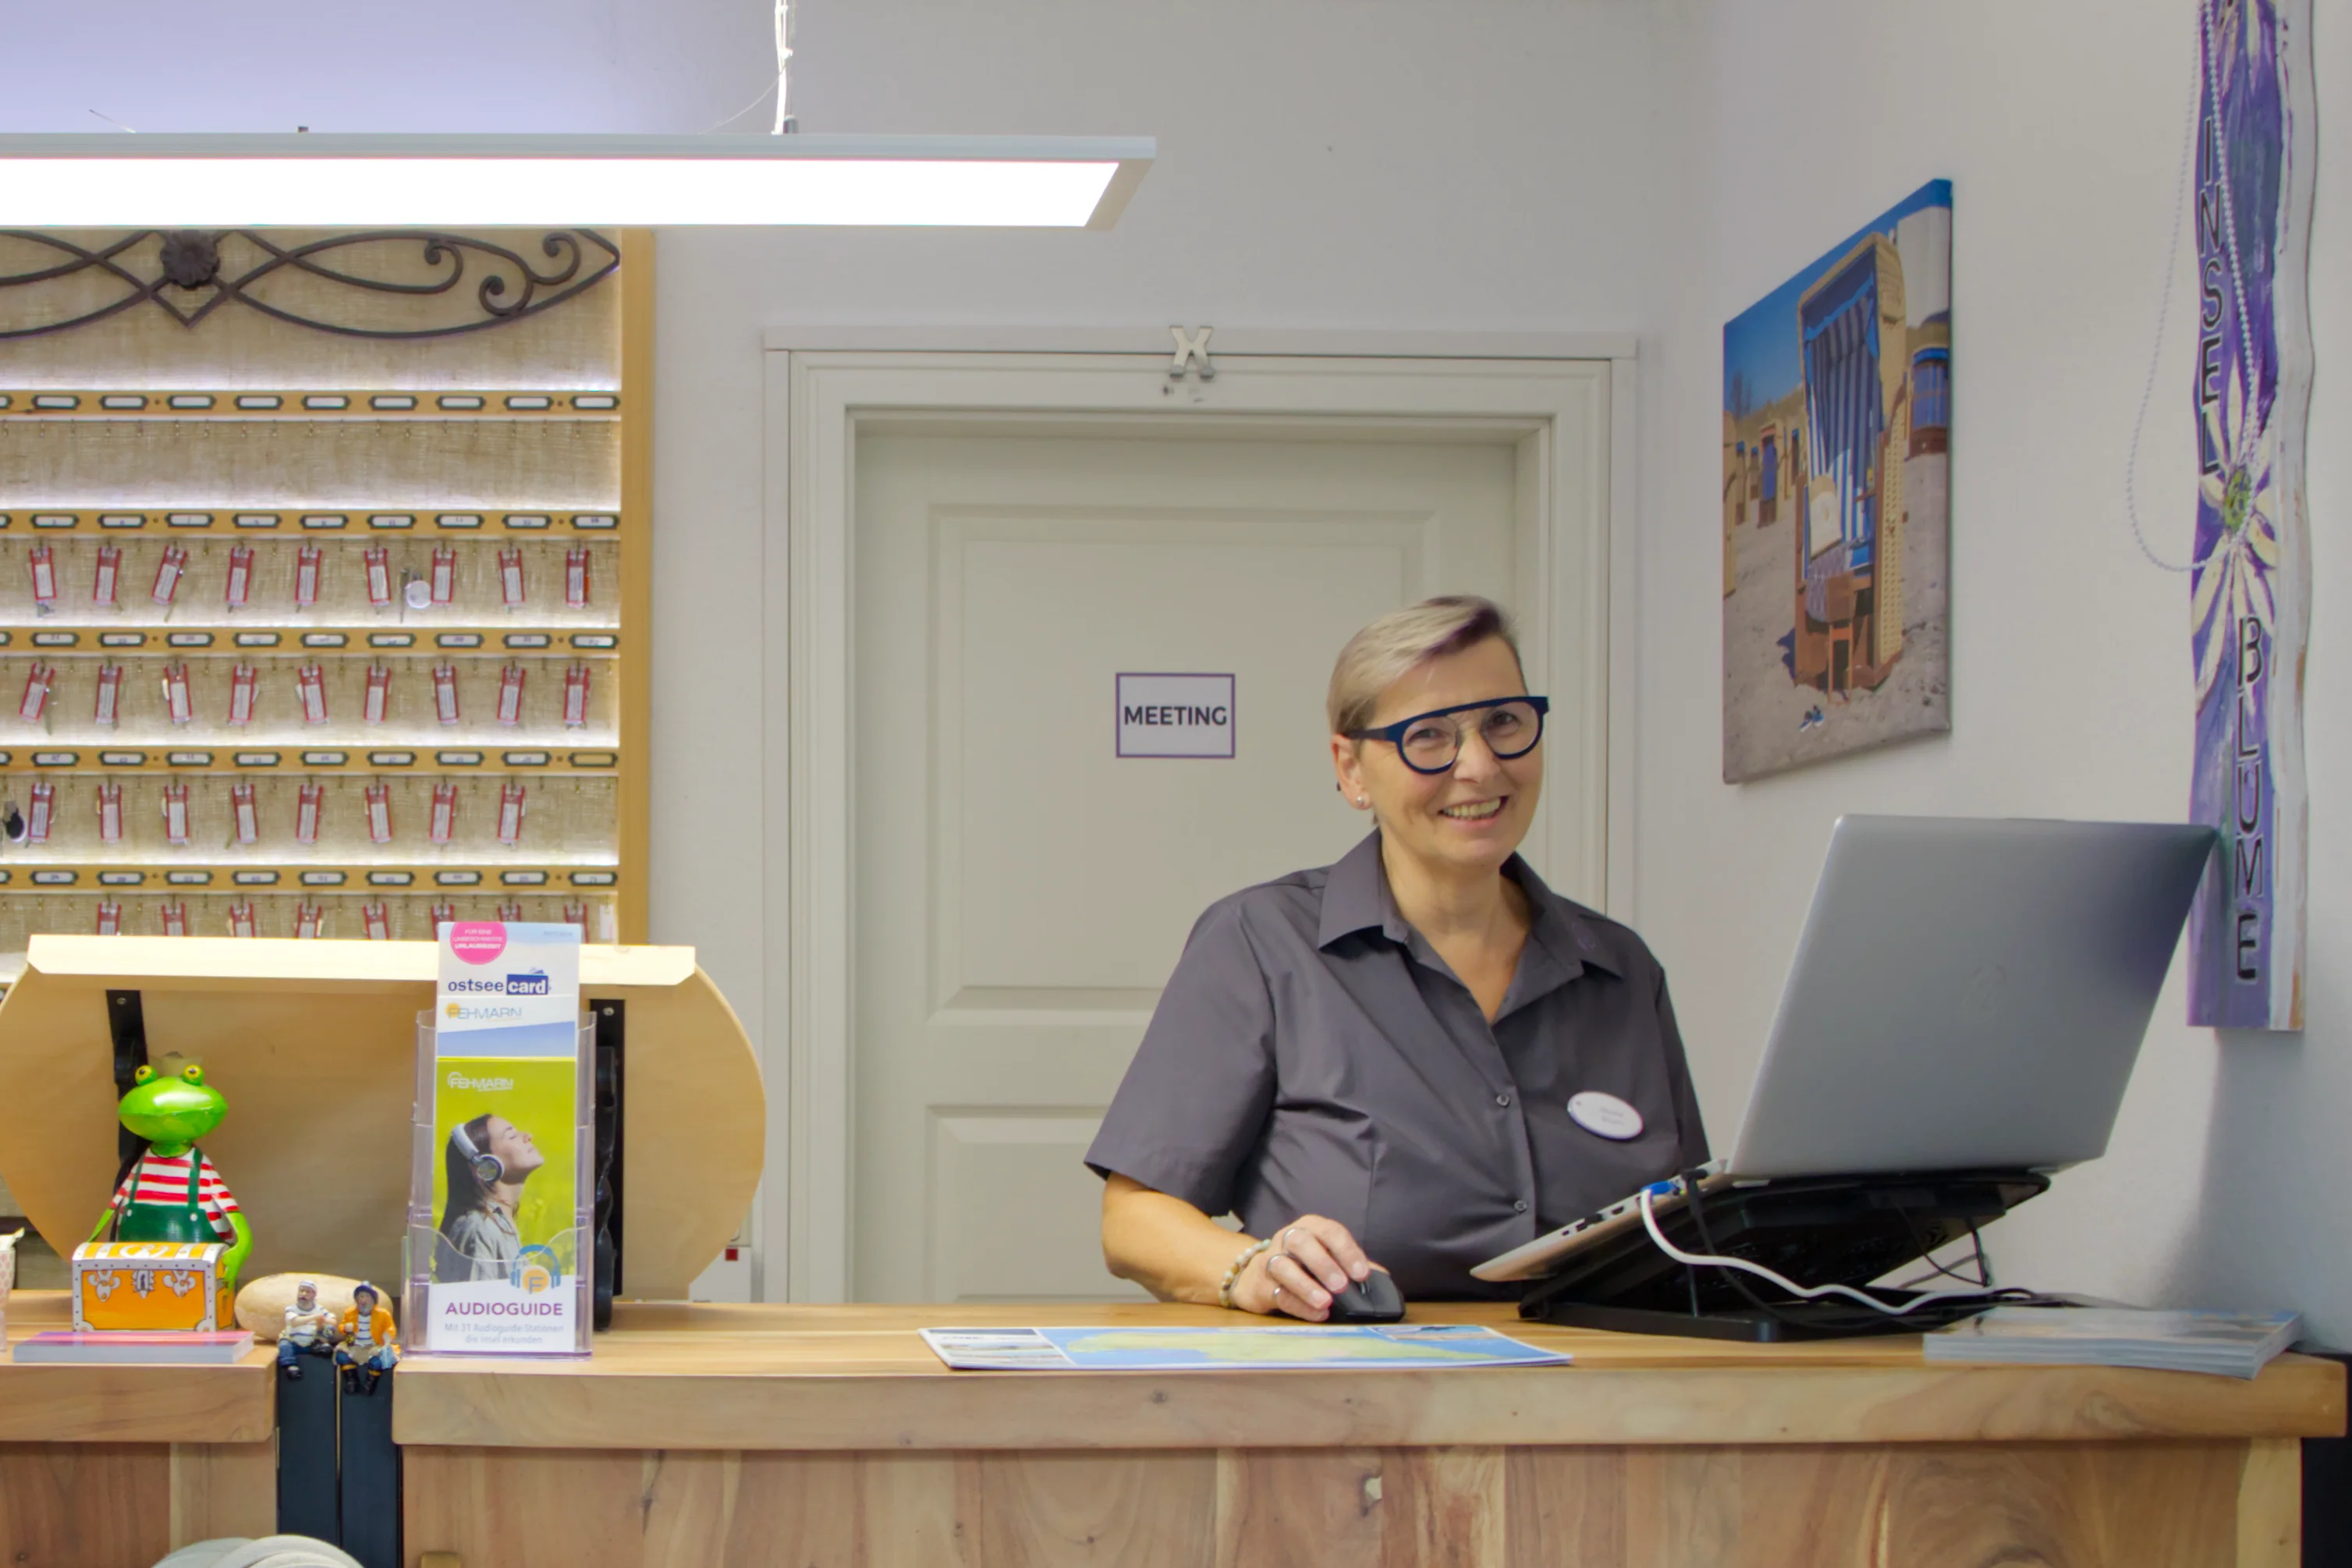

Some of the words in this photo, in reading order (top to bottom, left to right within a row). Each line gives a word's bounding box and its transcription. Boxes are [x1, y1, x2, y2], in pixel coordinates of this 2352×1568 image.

[2199, 117, 2223, 476] INSEL
[1124, 706, 1227, 725] MEETING
[2234, 616, 2262, 982] BLUME
[448, 979, 504, 992] ostsee
[508, 979, 546, 994] card
[448, 1007, 523, 1020] FEHMARN
[450, 1077, 514, 1090] FEHMARN
[445, 1302, 563, 1315] AUDIOGUIDE
[445, 1323, 458, 1332] Mit
[466, 1335, 478, 1343] die
